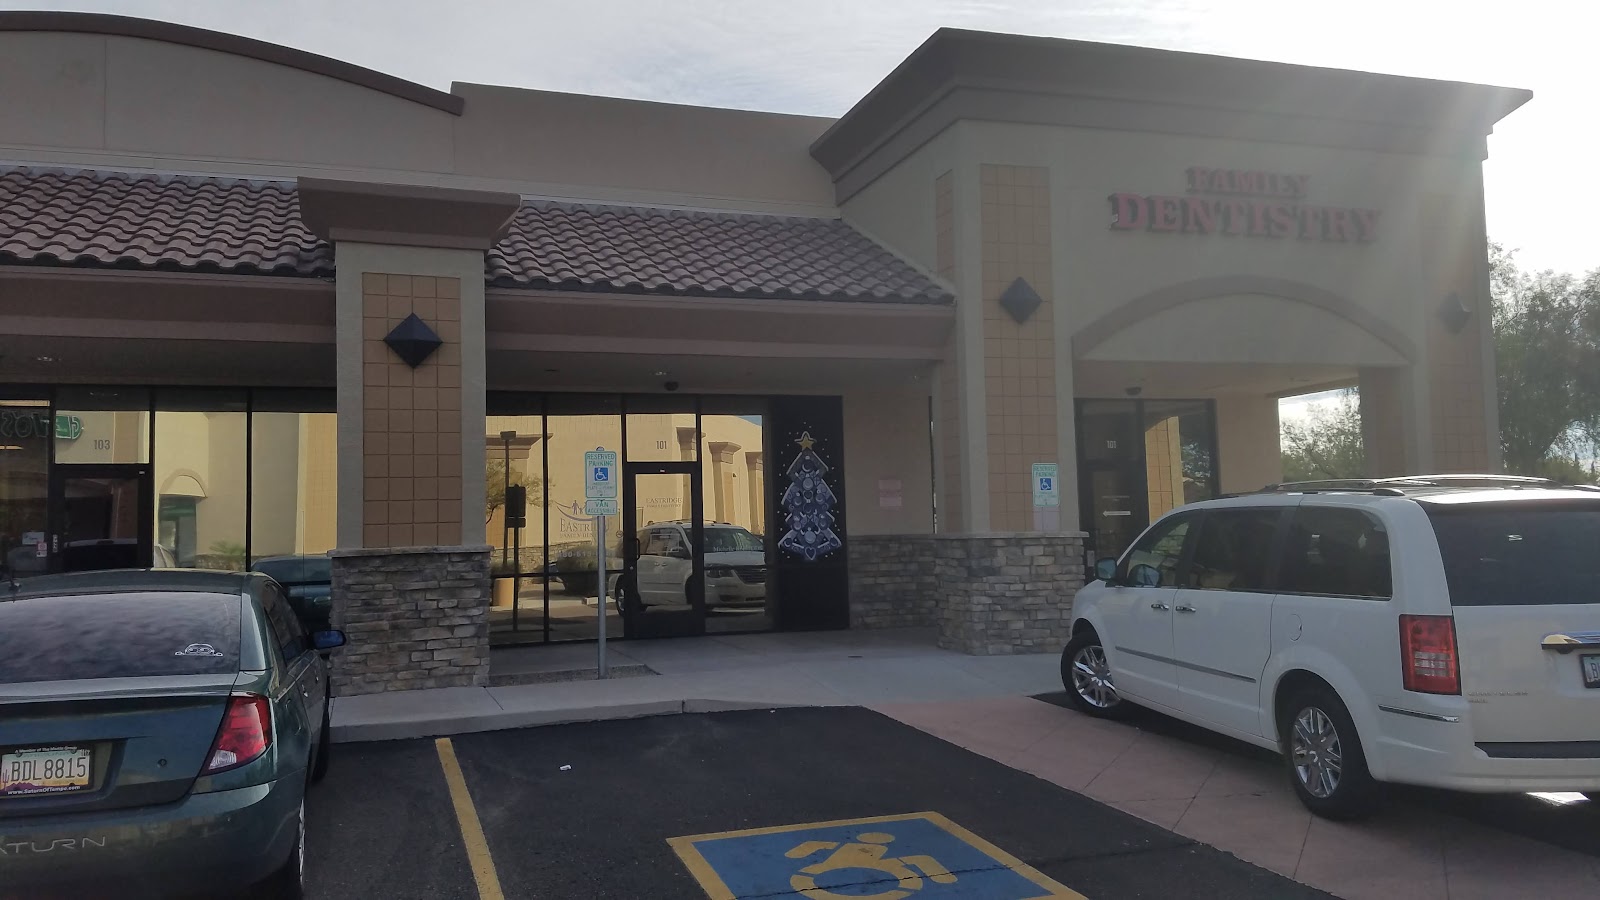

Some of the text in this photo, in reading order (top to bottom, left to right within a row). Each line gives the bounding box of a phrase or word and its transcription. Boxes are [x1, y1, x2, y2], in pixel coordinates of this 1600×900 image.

[1186, 167, 1310, 197] FAMILY
[1108, 193, 1381, 242] DENTISTRY
[94, 440, 111, 450] 103
[656, 440, 667, 450] 101
[1106, 440, 1117, 449] 101
[11, 757, 86, 781] BDL8815
